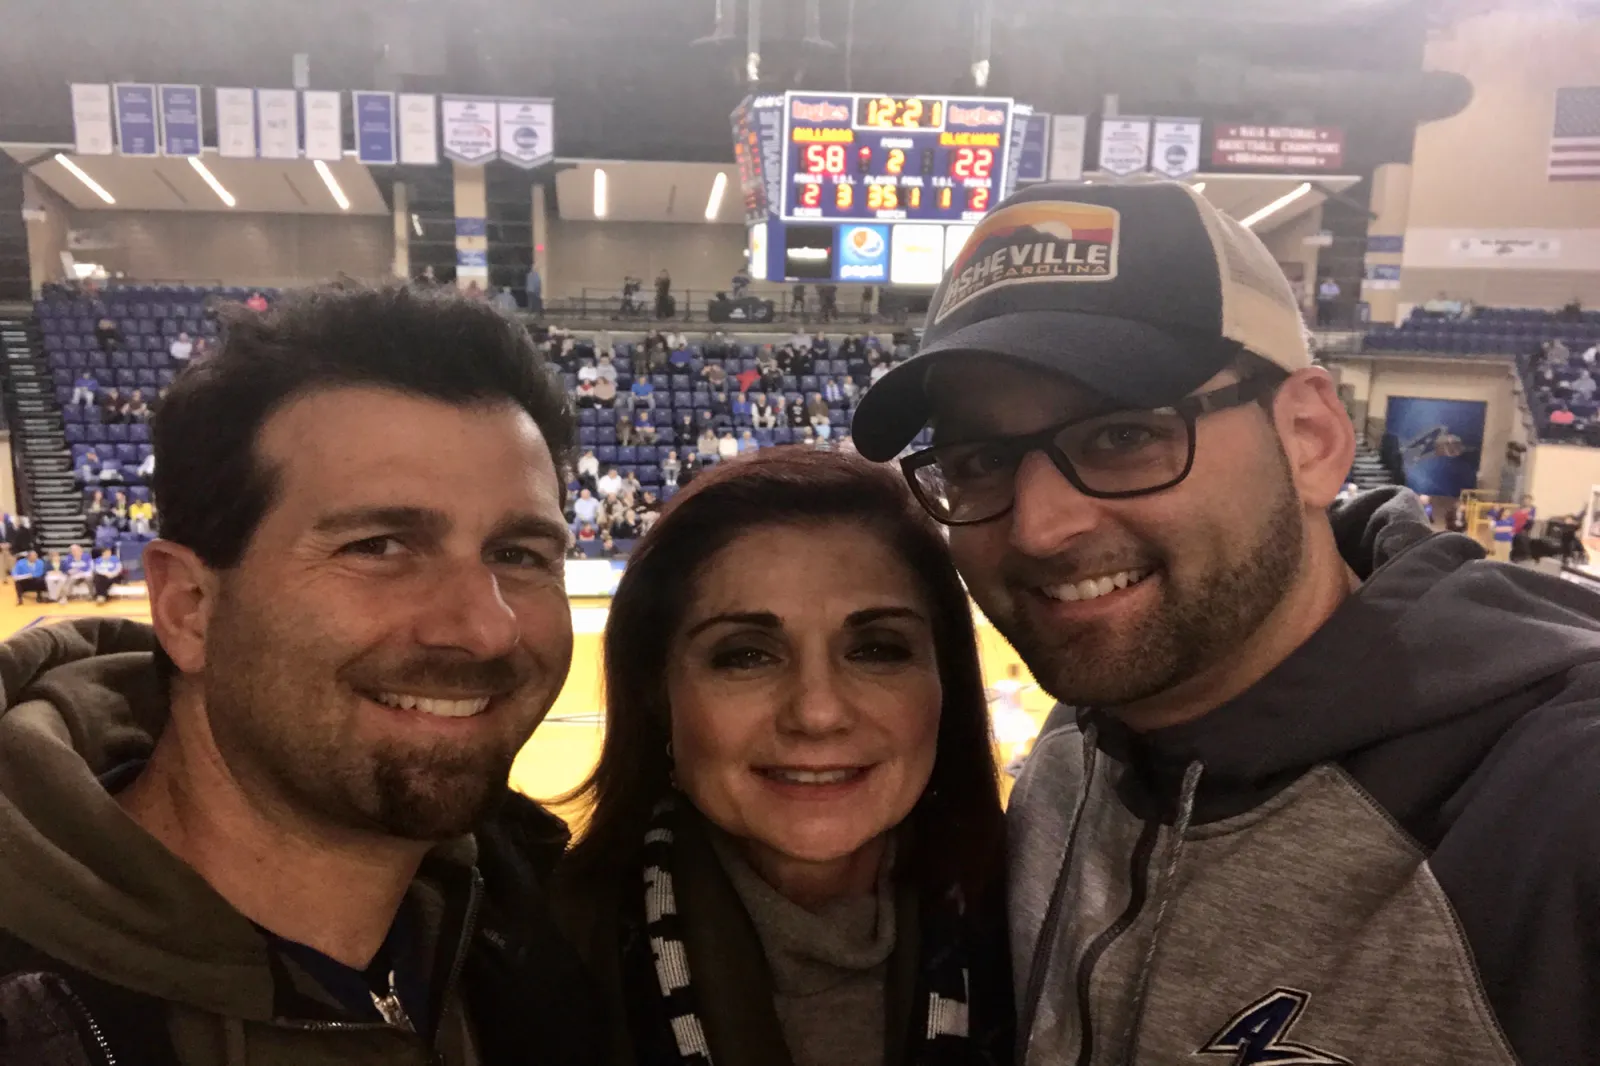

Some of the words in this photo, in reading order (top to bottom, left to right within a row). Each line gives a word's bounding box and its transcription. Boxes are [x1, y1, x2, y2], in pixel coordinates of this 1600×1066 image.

[867, 97, 942, 129] 12:21
[807, 144, 845, 174] 58
[886, 148, 905, 174] 2
[954, 148, 994, 178] 22
[802, 182, 821, 207] 2
[835, 182, 853, 209] 3
[867, 183, 899, 209] 35
[909, 186, 921, 209] 1
[941, 186, 952, 209] 1
[971, 187, 989, 211] 2
[992, 262, 1109, 282] CAROLINA
